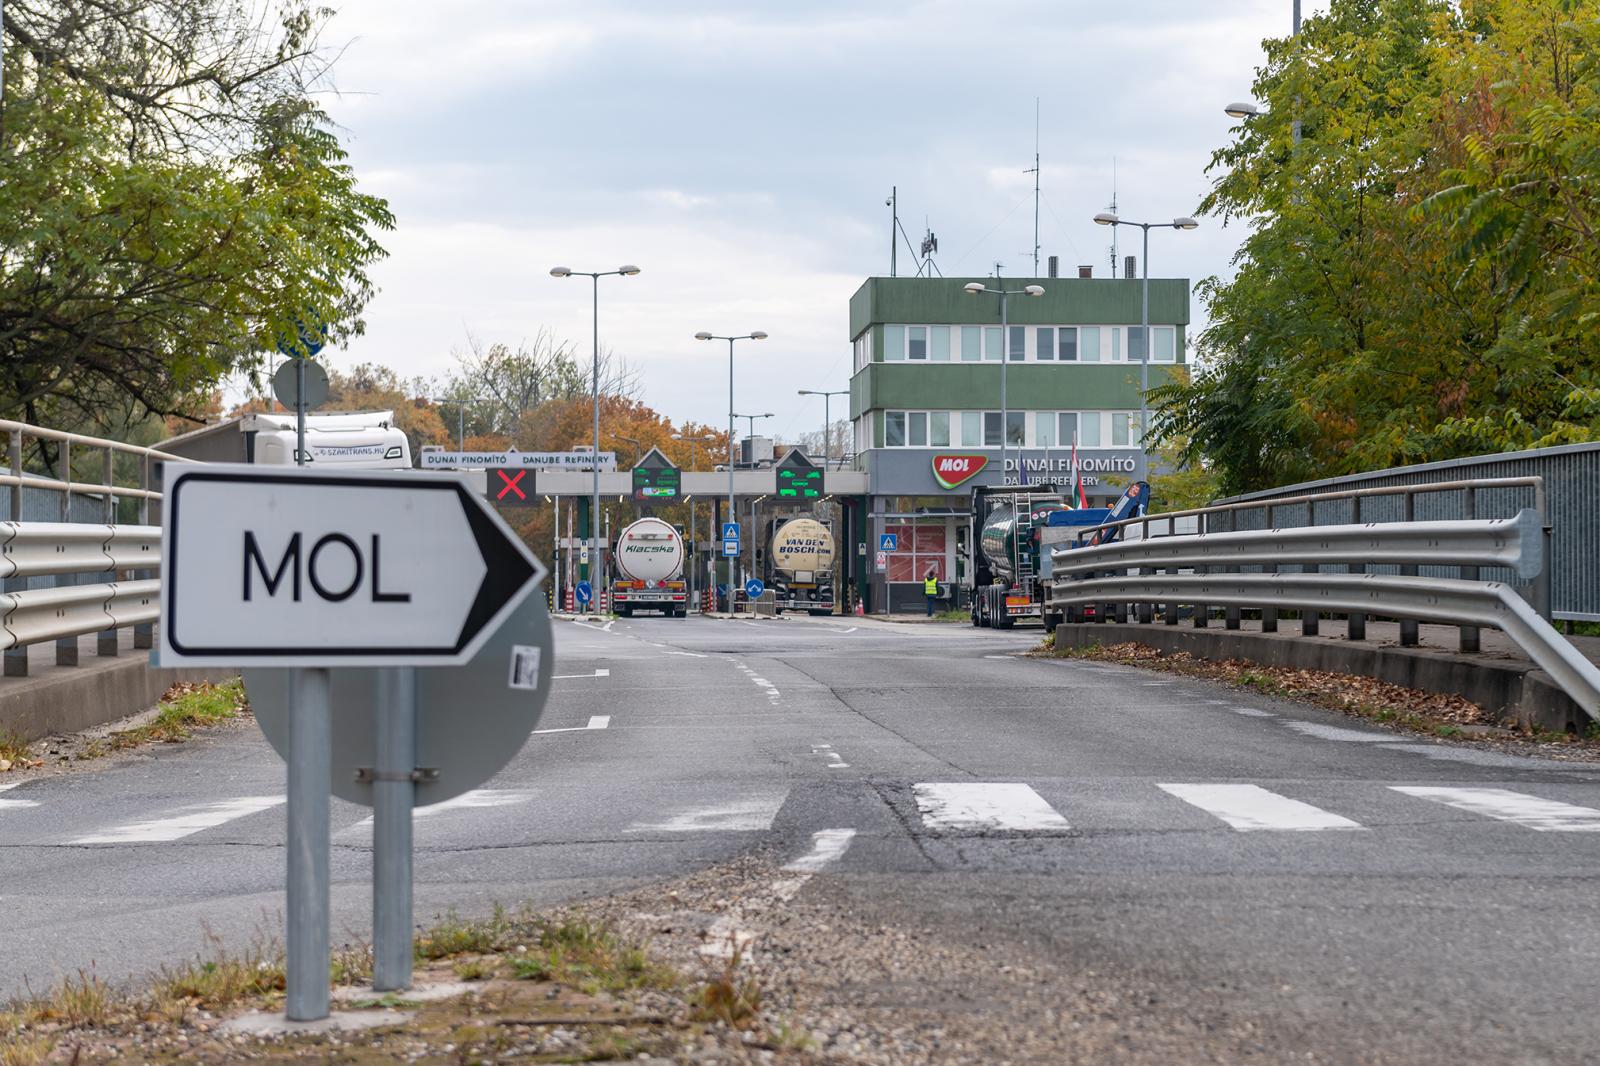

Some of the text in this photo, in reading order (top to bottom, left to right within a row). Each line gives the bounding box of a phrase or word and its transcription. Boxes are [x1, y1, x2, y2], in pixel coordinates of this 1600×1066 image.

[428, 454, 507, 464] DUNAI FINOMÍTÓ
[522, 456, 560, 464] DANUBE
[939, 458, 970, 472] MOL
[1004, 476, 1100, 486] DAUBE REFIERY
[786, 538, 804, 546] VAN
[625, 544, 674, 553] Klacska
[242, 530, 412, 603] MOL
